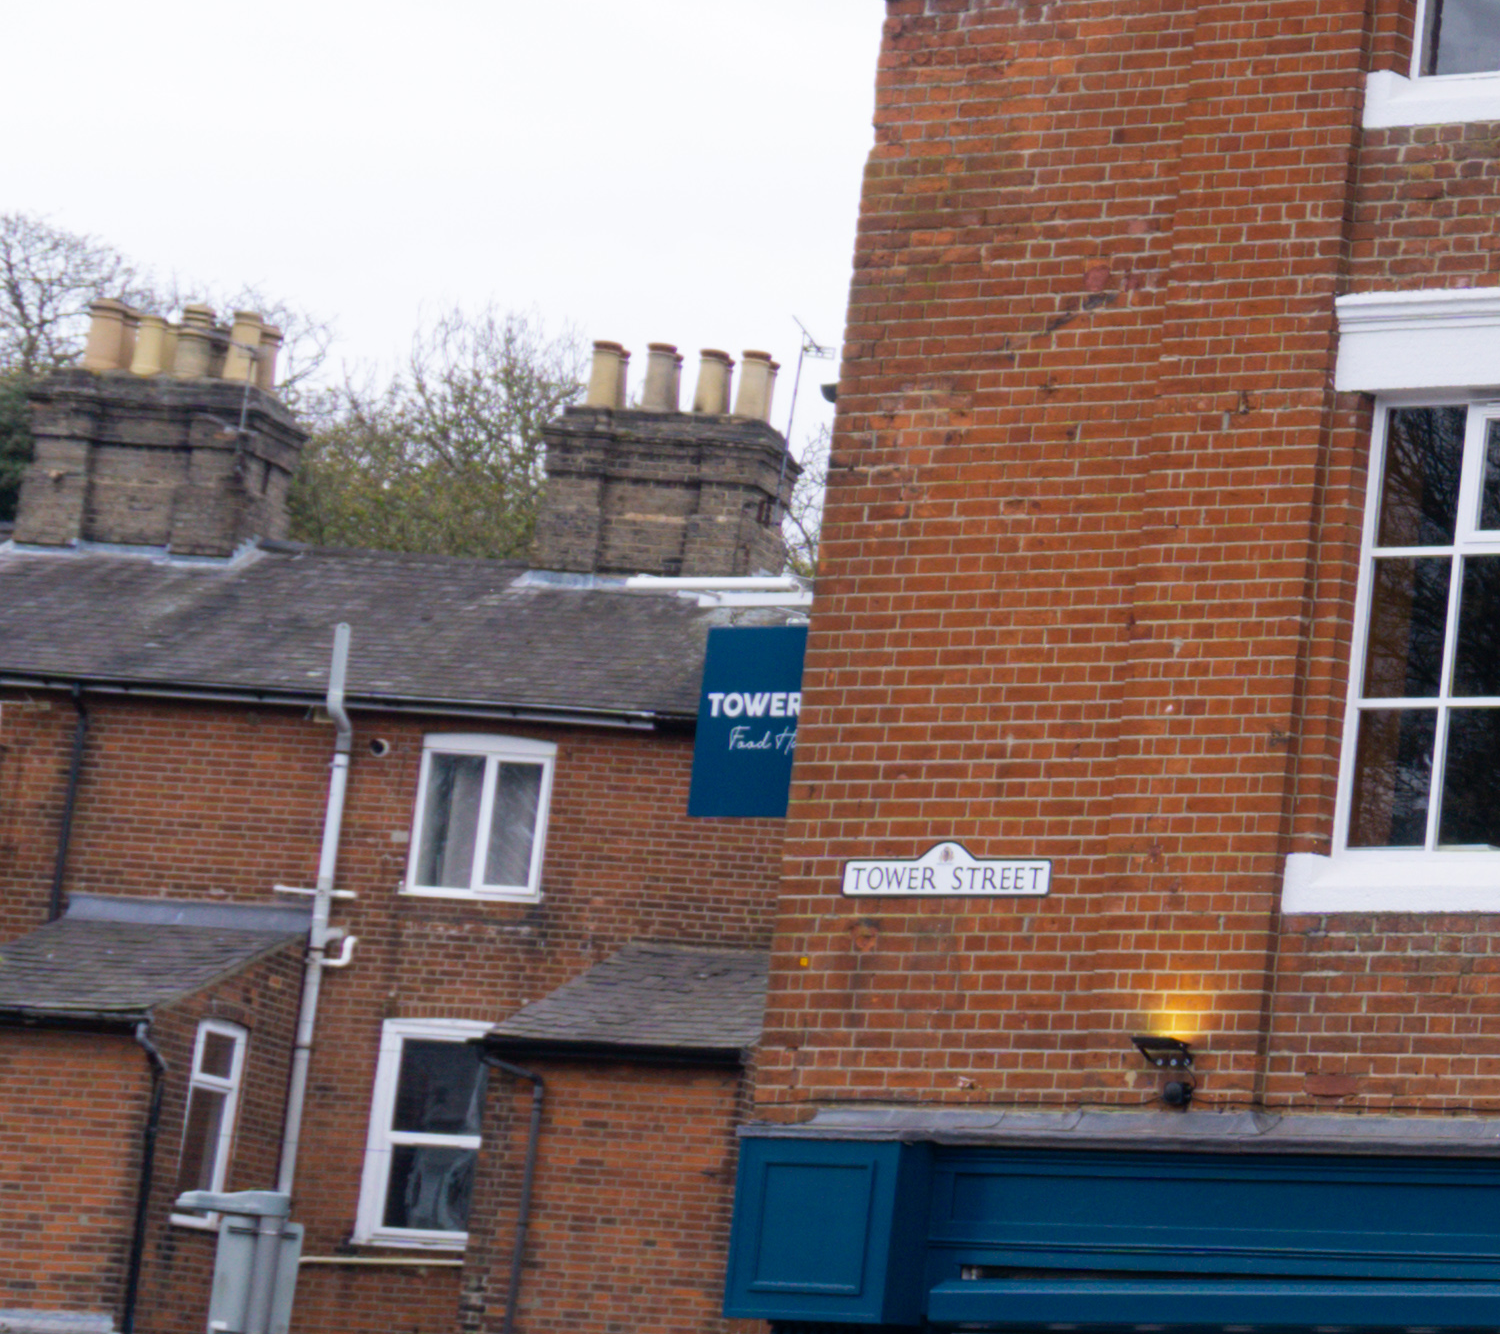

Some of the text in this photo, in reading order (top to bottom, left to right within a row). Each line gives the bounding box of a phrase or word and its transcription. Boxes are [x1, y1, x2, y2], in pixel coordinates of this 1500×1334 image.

[728, 725, 771, 751] Food
[852, 867, 1044, 890] TOWER STREET
